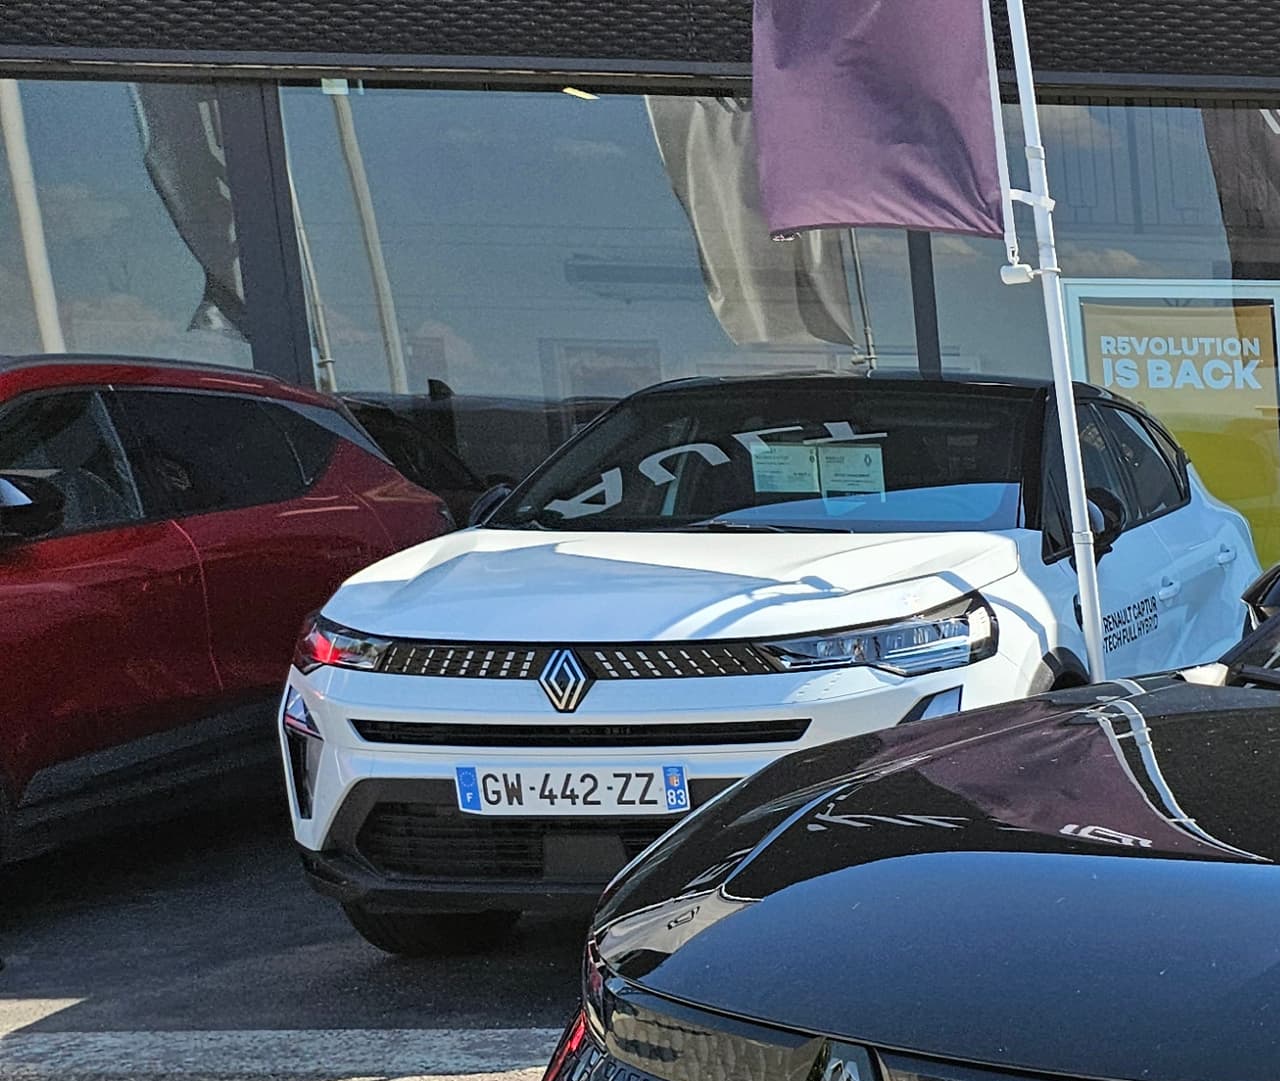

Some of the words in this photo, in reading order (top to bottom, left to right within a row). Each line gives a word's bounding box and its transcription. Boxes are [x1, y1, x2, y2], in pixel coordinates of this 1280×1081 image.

[1100, 335, 1260, 356] R5VOLUTION
[1102, 357, 1140, 389] IS
[1147, 359, 1262, 390] BACK
[1103, 606, 1132, 633] RENAULT
[1132, 595, 1158, 620] CAPTUR
[1122, 623, 1138, 645] FULL
[466, 792, 473, 803] F
[481, 772, 658, 806] GW-442-ZZ
[667, 789, 686, 806] 83
